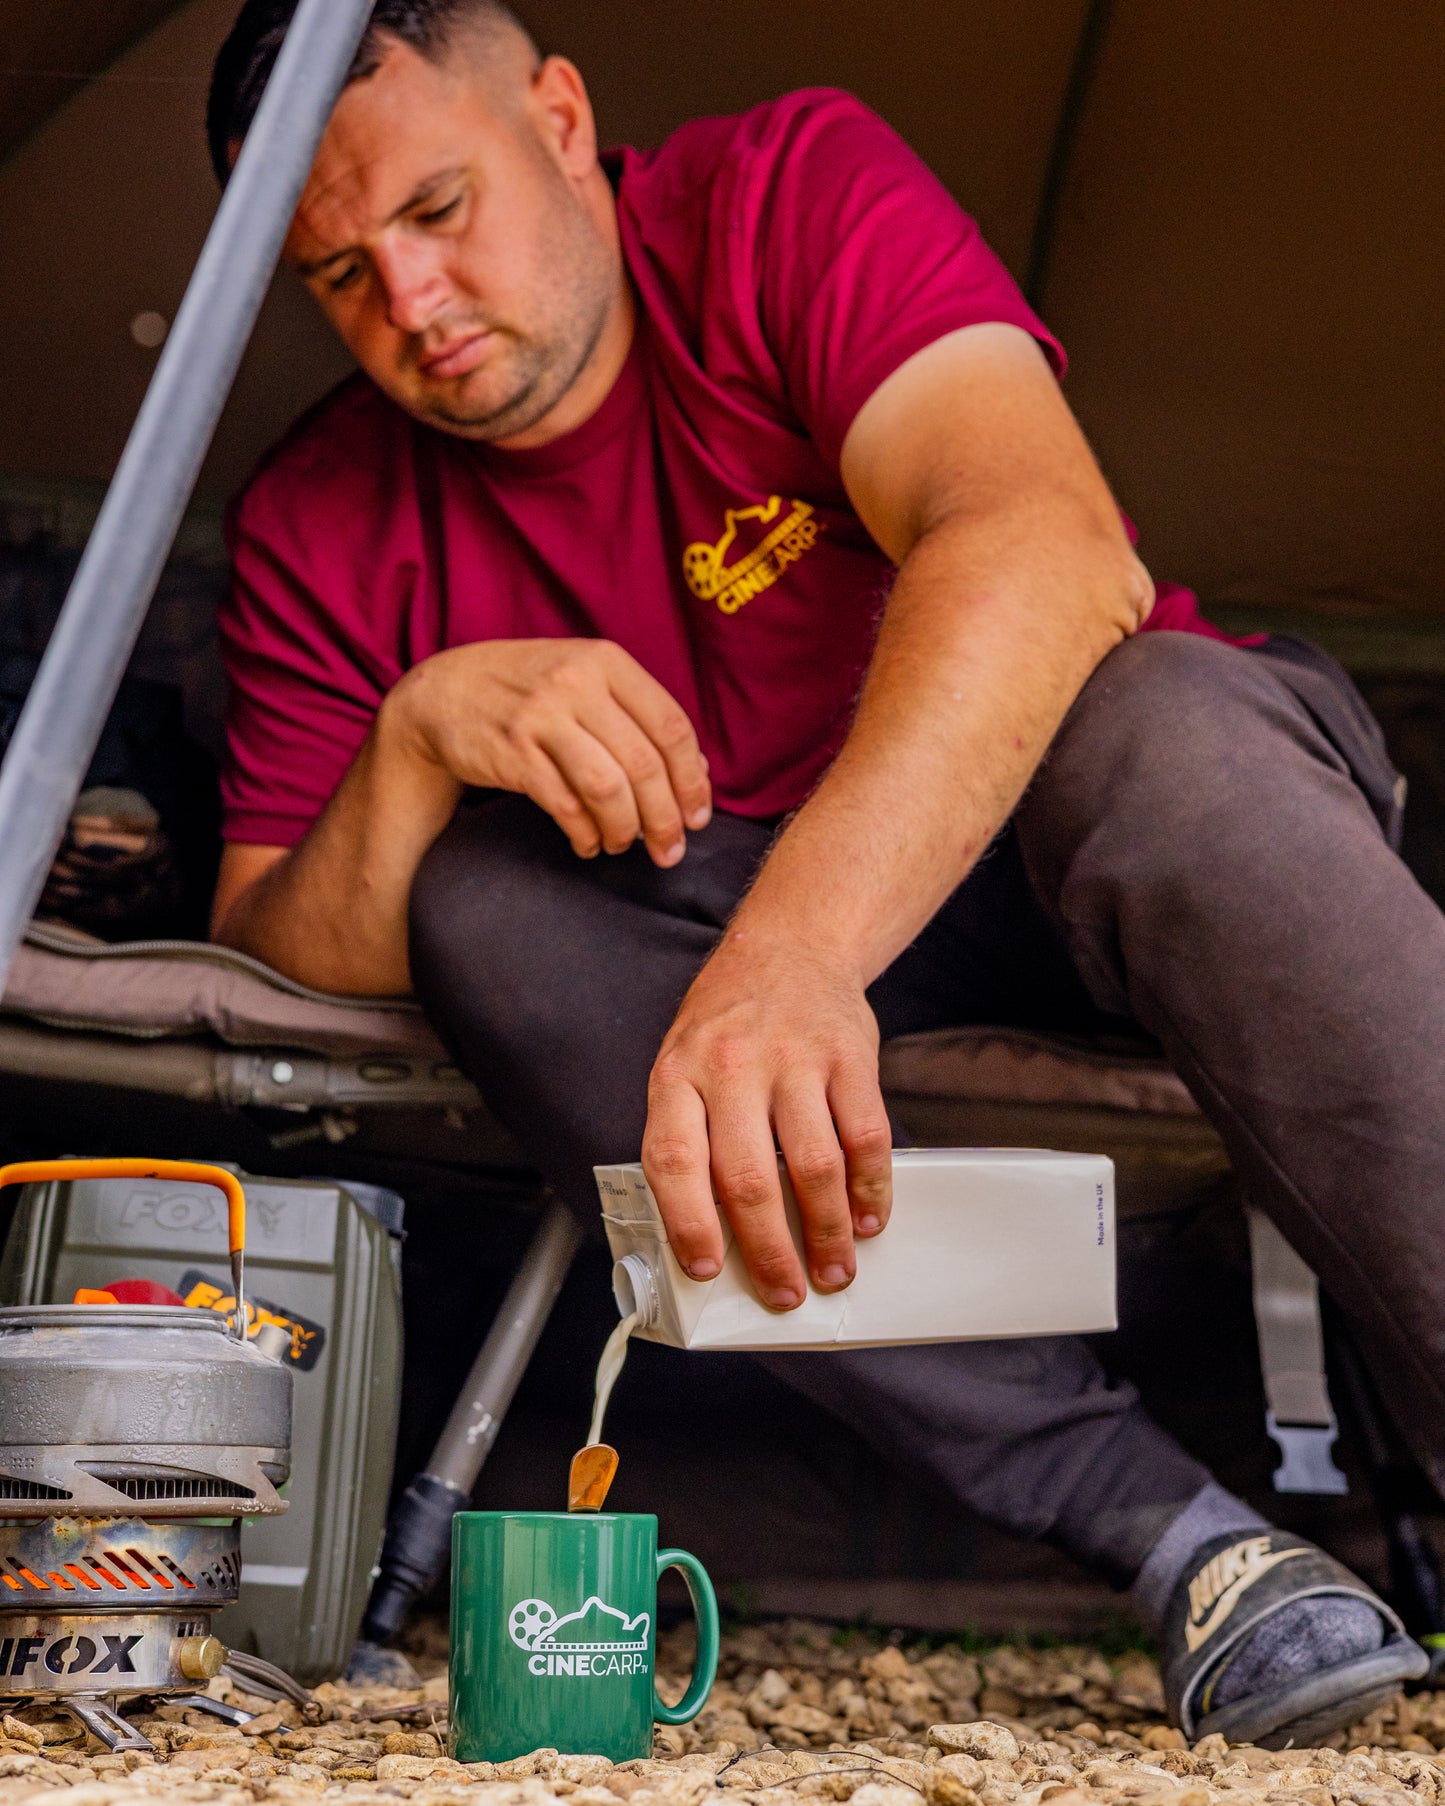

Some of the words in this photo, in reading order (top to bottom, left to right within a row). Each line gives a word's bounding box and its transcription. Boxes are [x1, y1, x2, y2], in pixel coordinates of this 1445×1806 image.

[1096, 1183, 1104, 1196] UK
[1096, 1197, 1104, 1211] the
[1097, 1222, 1105, 1246] Made
[1188, 1535, 1273, 1624] NIKE
